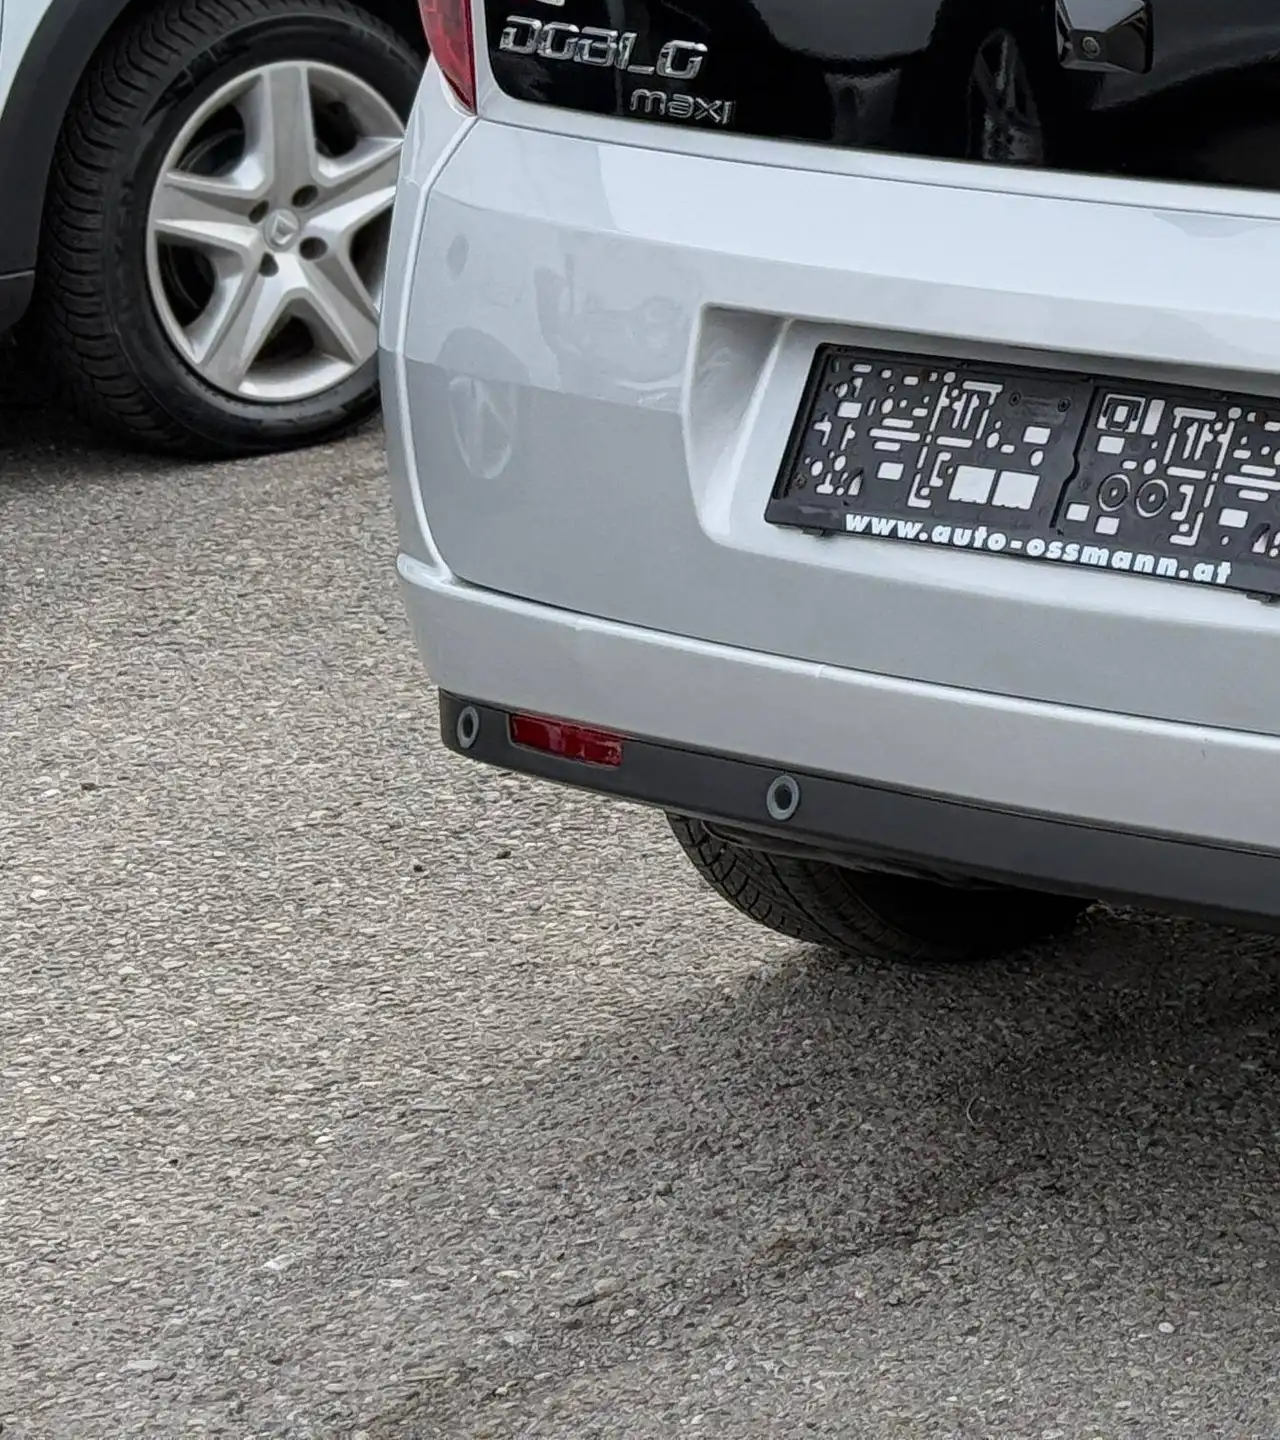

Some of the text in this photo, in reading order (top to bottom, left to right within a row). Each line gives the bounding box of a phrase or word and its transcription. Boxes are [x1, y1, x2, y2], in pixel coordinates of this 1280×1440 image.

[499, 15, 708, 79] DOBLO
[630, 88, 736, 124] maxi
[845, 513, 1232, 584] www.auto-ossmann.at
